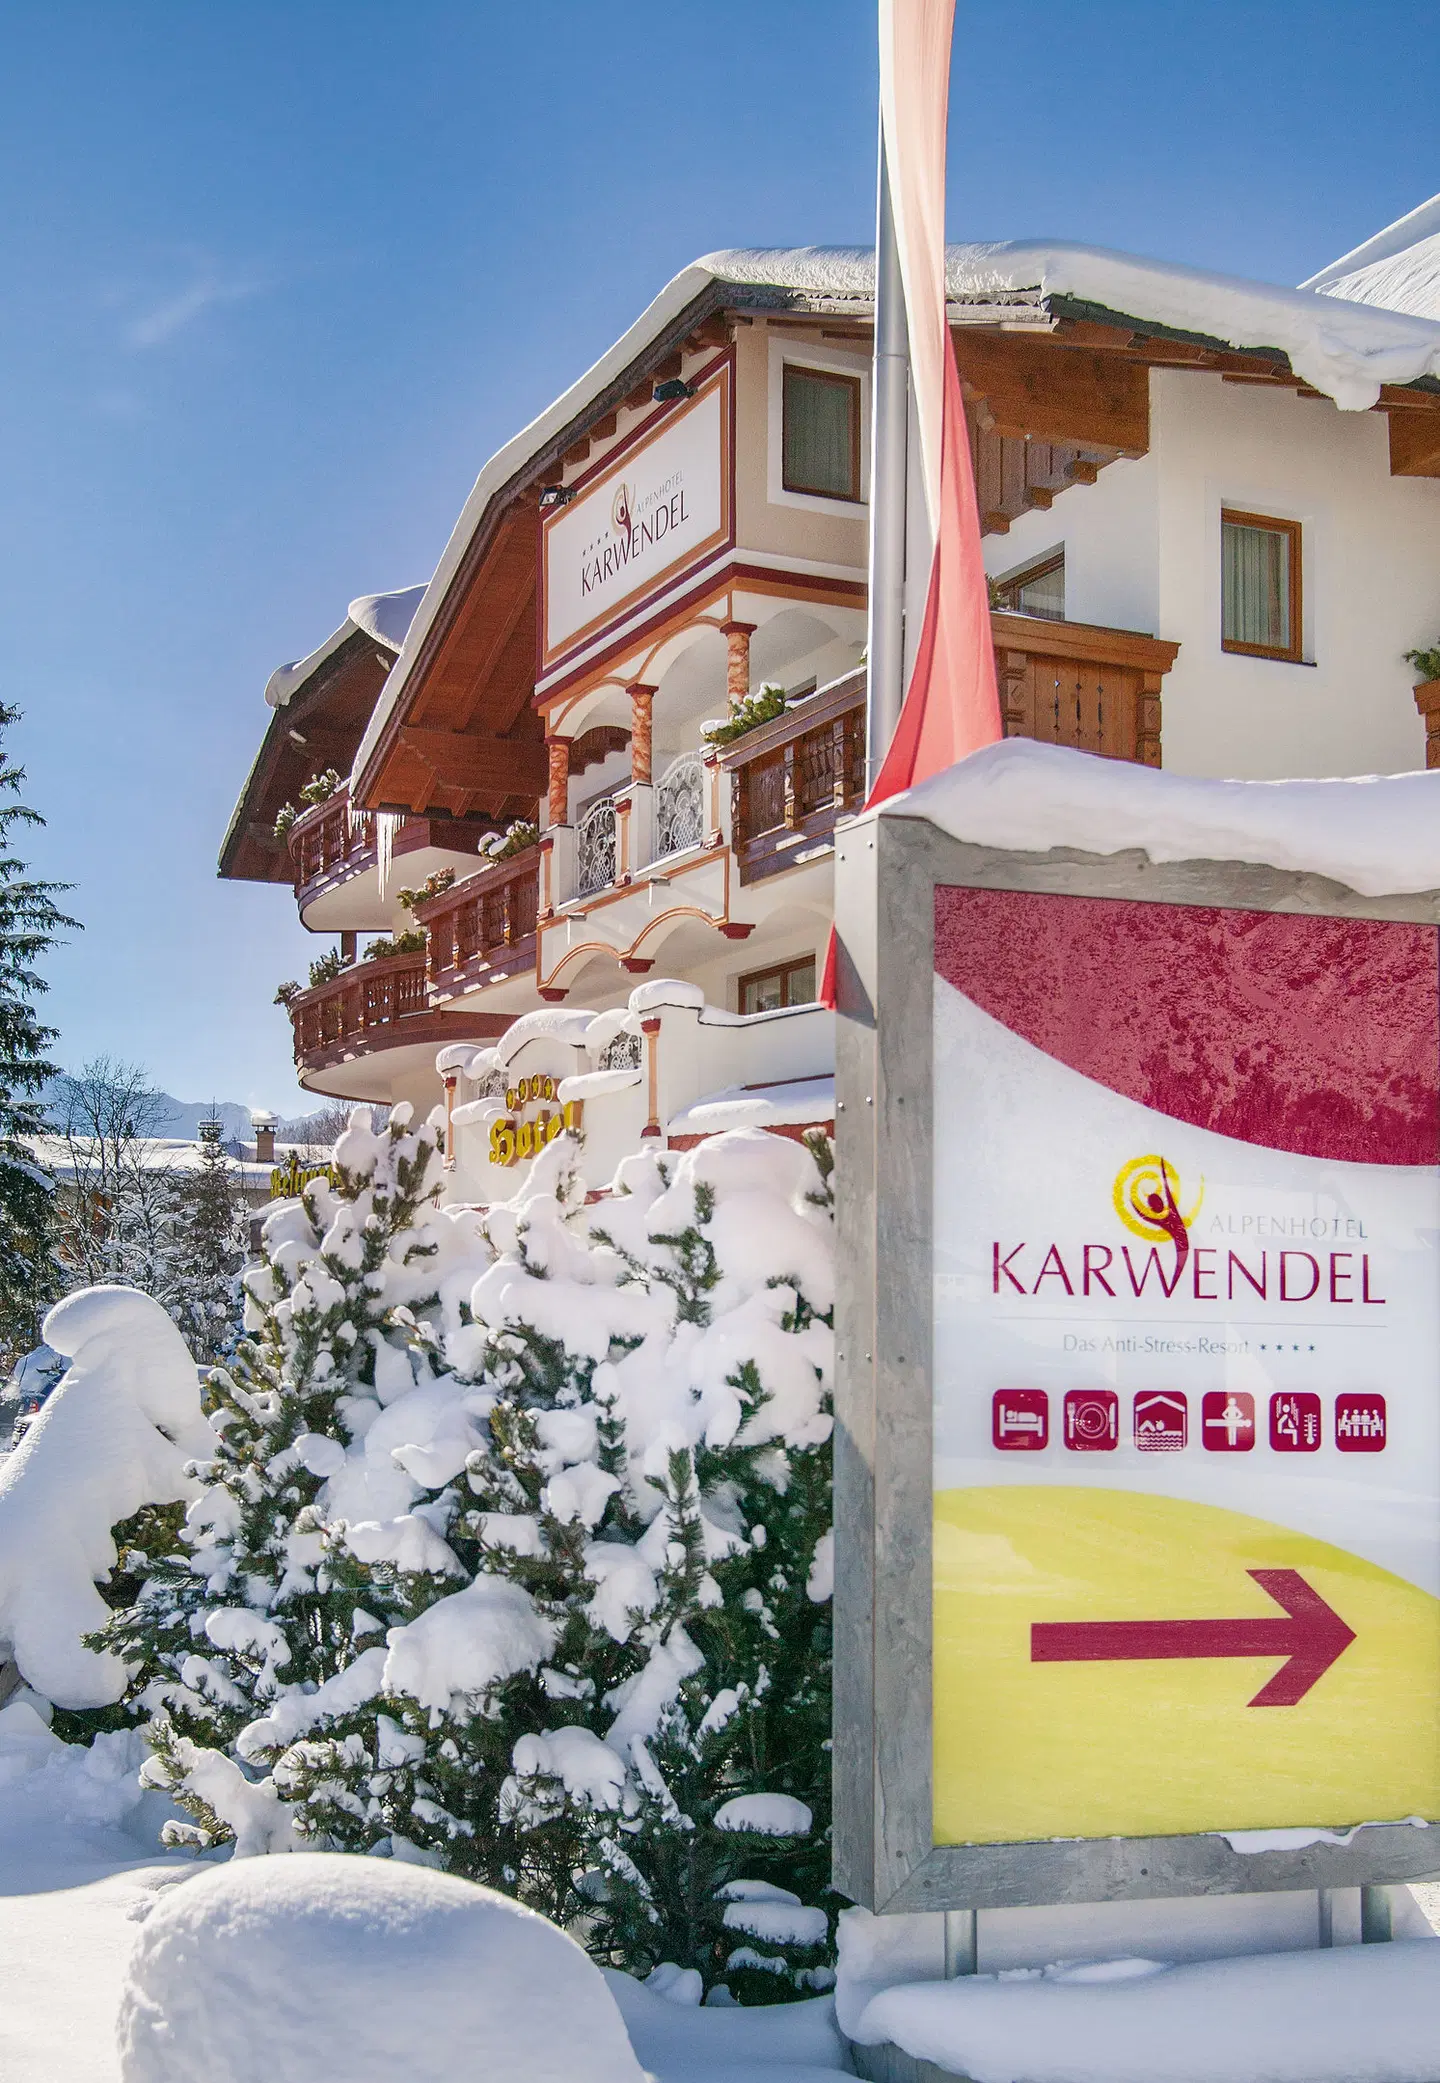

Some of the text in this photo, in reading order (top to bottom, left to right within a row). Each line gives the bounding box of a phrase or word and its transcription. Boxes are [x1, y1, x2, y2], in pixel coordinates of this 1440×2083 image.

[635, 470, 685, 514] ALPENHOTEL
[581, 490, 690, 597] KARWENDEL
[1208, 1213, 1370, 1241] ALPENHOTEL
[991, 1241, 1387, 1305] KARWENDEL
[1063, 1334, 1250, 1355] Das Anti-Stress-Resort
